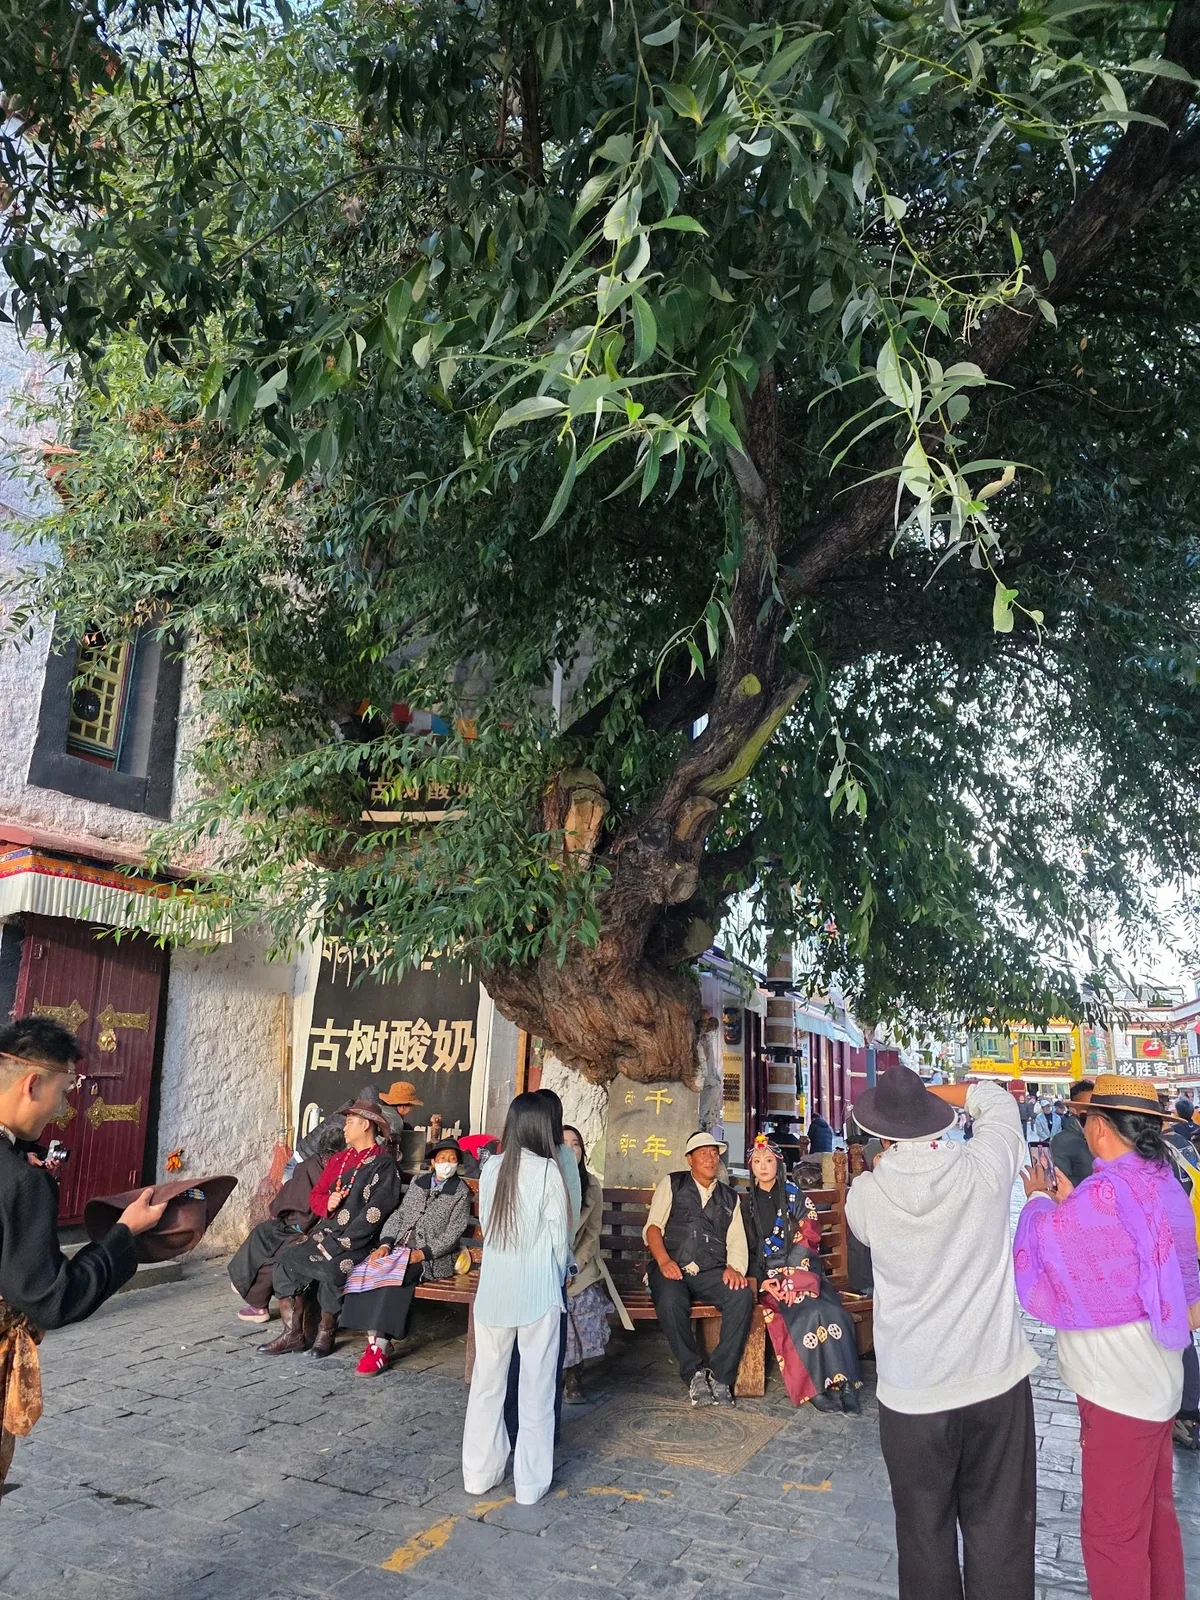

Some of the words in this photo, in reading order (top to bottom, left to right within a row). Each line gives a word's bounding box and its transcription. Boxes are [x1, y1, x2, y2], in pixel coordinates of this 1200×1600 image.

[310, 1017, 476, 1073] 古树酸奶
[1119, 1061, 1168, 1077] 必胜客
